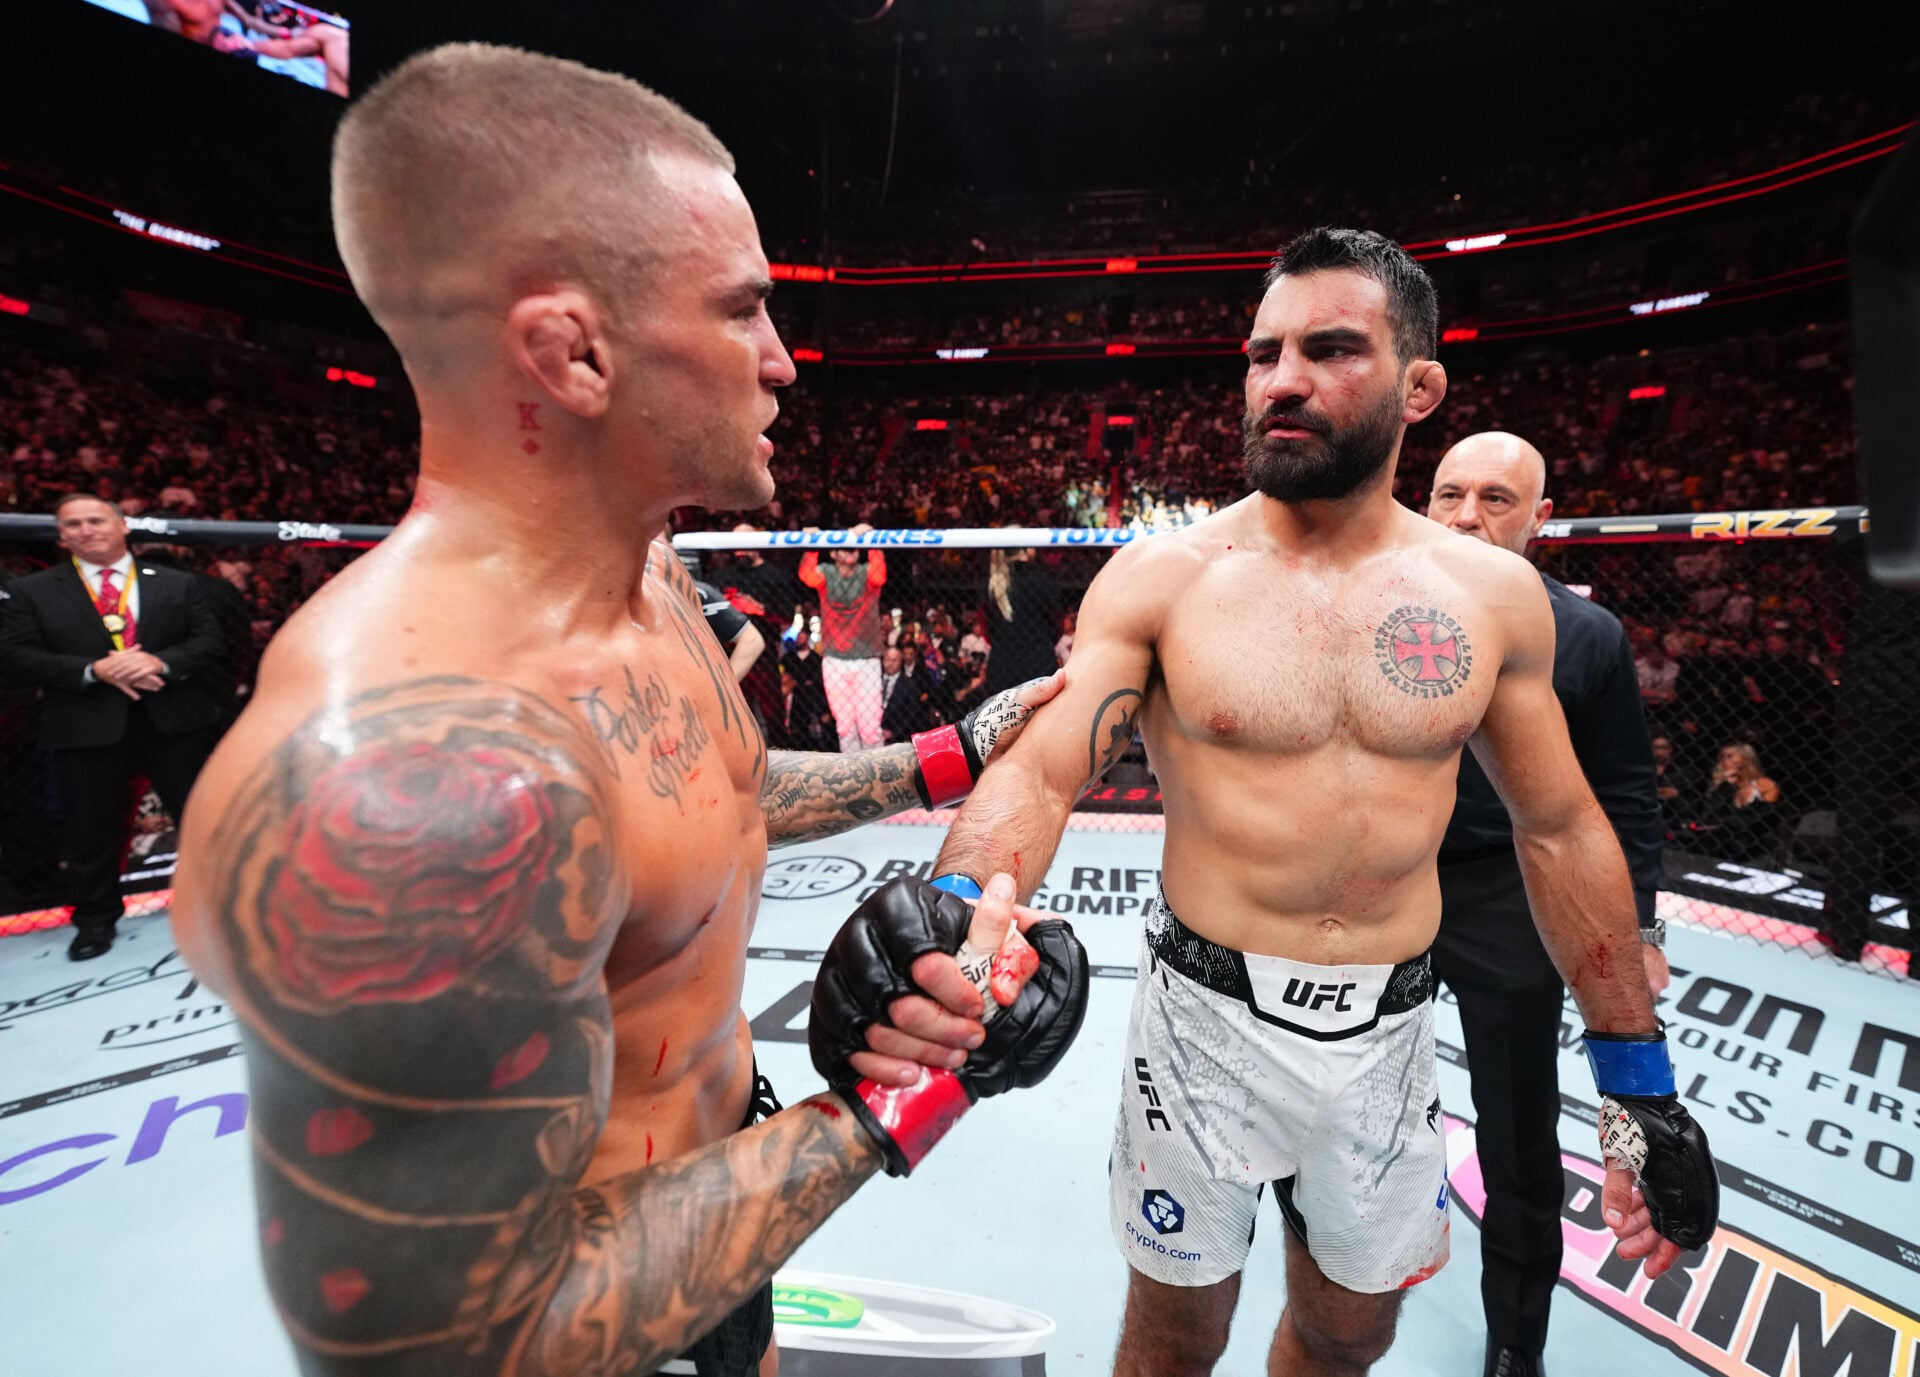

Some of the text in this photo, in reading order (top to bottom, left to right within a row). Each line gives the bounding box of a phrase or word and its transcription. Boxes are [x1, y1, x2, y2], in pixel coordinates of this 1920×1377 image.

[515, 401, 543, 431] K
[278, 521, 341, 542] Stake
[856, 529, 944, 545] TIRES
[1049, 528, 1135, 544] TOYO
[1691, 508, 1836, 539] RIZZ
[1071, 867, 1162, 893] RIF
[1282, 978, 1357, 1012] UFC
[1664, 1022, 1783, 1078] OUR
[1134, 1057, 1172, 1132] UFC
[1125, 1220, 1201, 1262] crypto.com
[1561, 1167, 1920, 1377] PRIM
